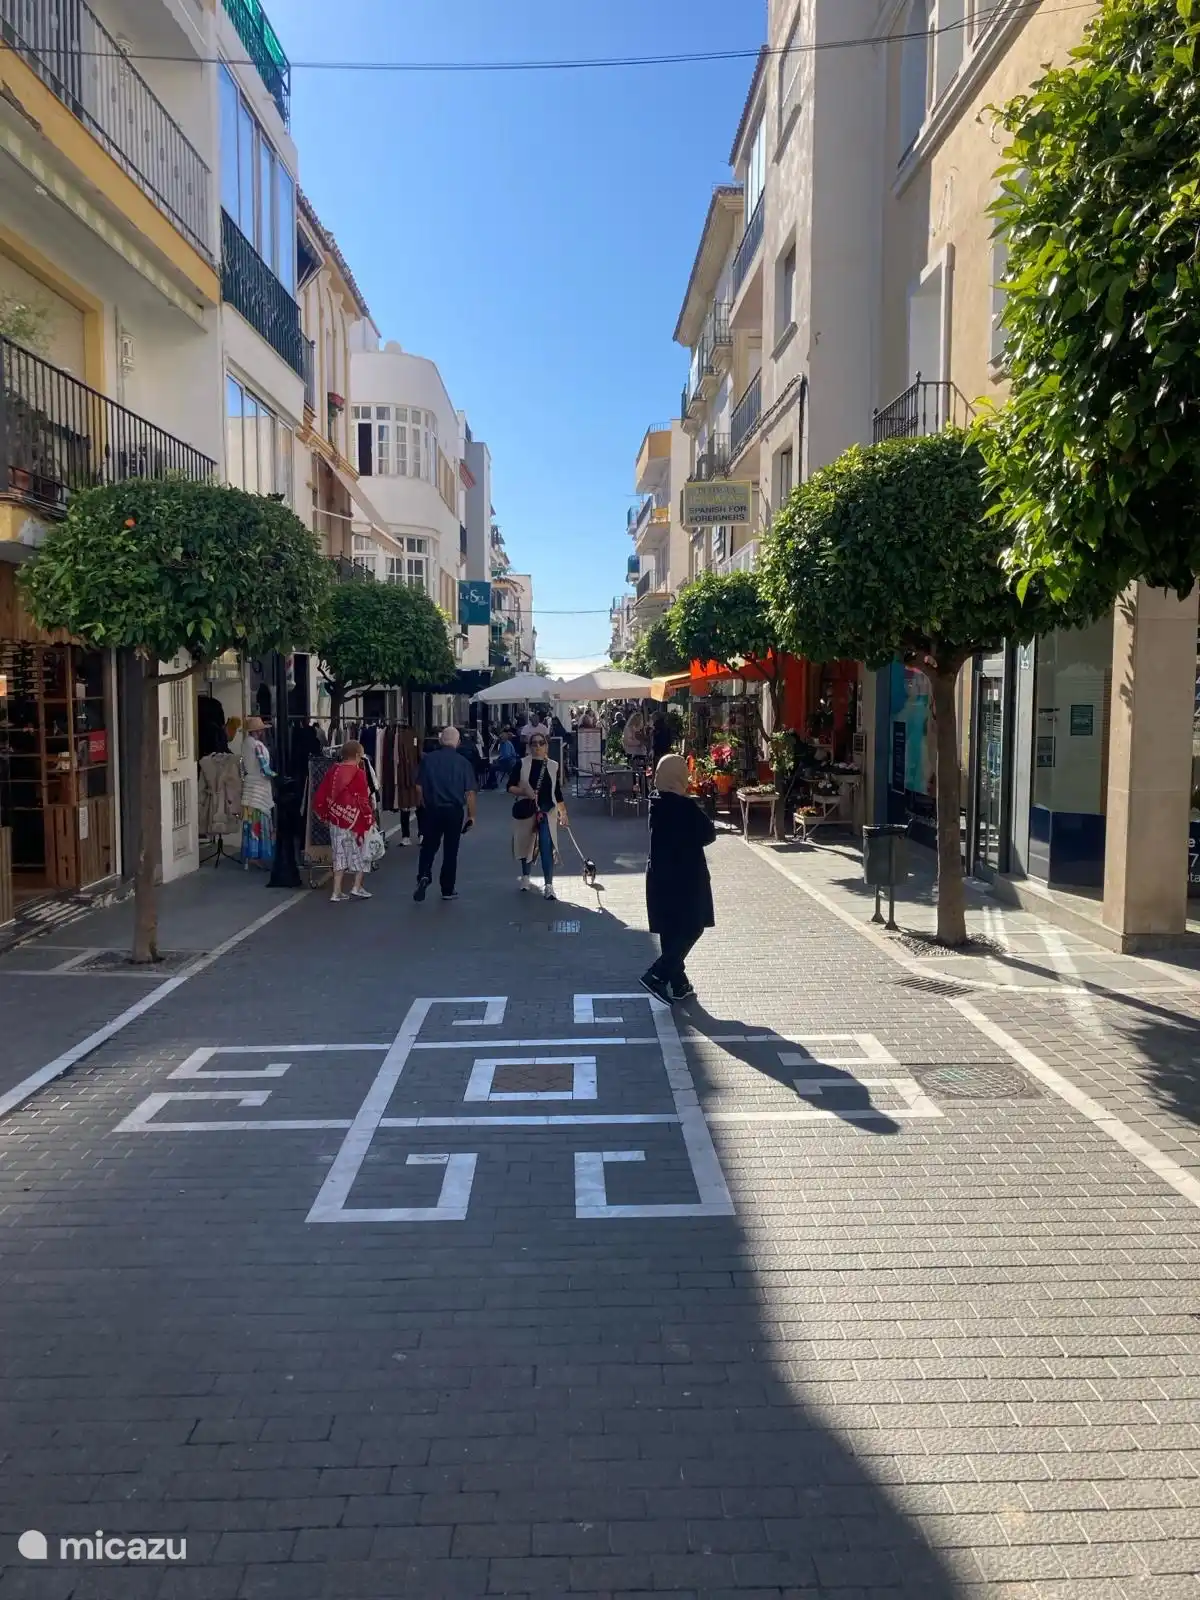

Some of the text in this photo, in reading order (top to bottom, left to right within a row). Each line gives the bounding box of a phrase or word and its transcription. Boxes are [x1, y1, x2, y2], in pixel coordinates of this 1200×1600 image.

[688, 505, 747, 515] SPANISH FOR
[689, 513, 745, 523] FOREIGNERS
